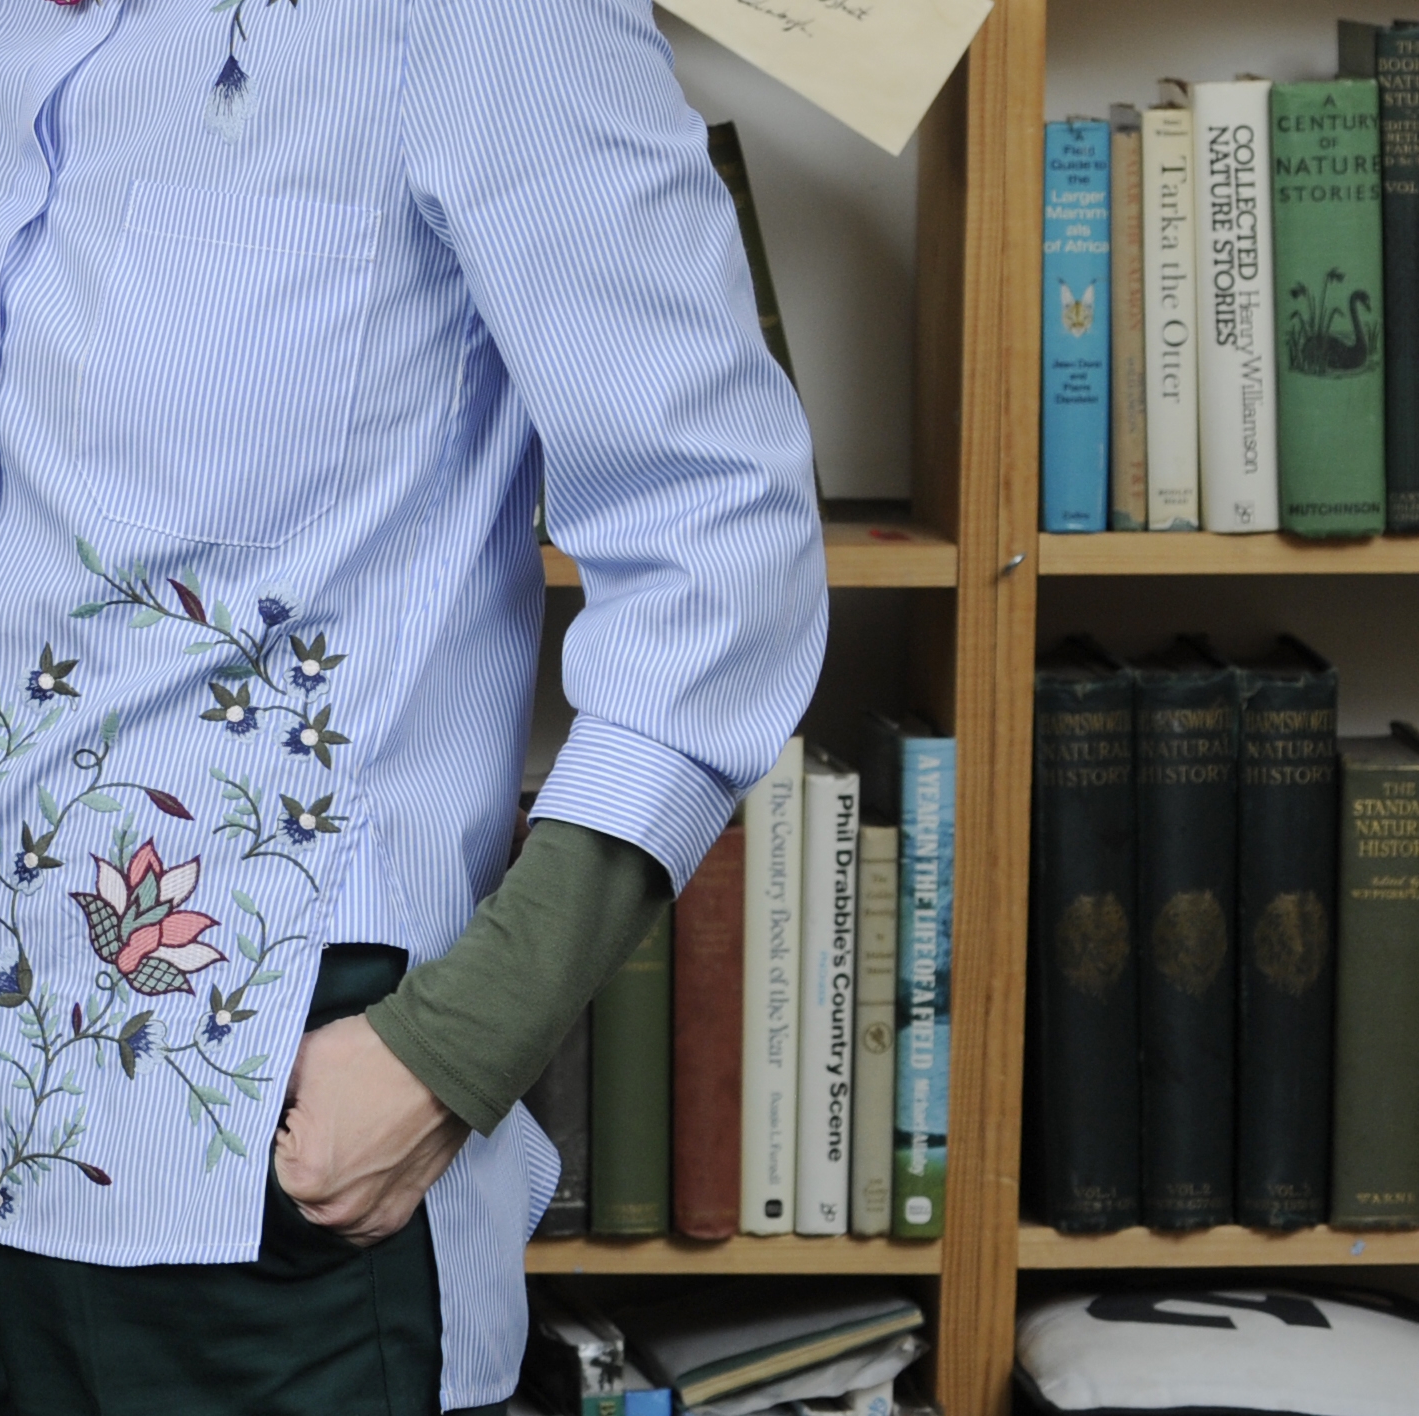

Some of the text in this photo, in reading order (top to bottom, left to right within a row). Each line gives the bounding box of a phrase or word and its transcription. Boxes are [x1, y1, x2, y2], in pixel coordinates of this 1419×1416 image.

[1323, 94, 1337, 107] A
[1277, 113, 1380, 133] CENTURY
[1063, 145, 1096, 157] Field
[1319, 136, 1339, 150] OF
[1050, 159, 1108, 171] Guide to
[1276, 154, 1382, 176] NATURE
[1067, 174, 1091, 185] the
[1051, 189, 1106, 206] Larger
[1279, 184, 1381, 203] STORIES
[1065, 223, 1092, 238] als
[1207, 124, 1238, 347] NATURE STORIES
[1043, 239, 1111, 253] of Africa
[1158, 155, 1191, 404] Tarka the Otter
[1231, 124, 1265, 475] COLLECTED Henry Williamson
[1288, 502, 1381, 517] HUTCHINSON
[1044, 742, 1132, 760] NATURAL
[1141, 738, 1234, 758] NATURAL
[1247, 739, 1336, 759] NATURAL
[917, 754, 938, 770] A
[1044, 766, 1132, 786] HISTORY
[1141, 764, 1232, 784] HISTORY
[1247, 765, 1333, 785] HISTORY
[916, 772, 938, 825] YEAR
[1383, 782, 1415, 796] THE
[915, 832, 937, 857] IN
[914, 860, 936, 904] THE
[912, 908, 935, 957] LIFE
[826, 793, 855, 1163] Phil Drabble's Country Scene
[911, 957, 934, 985] OF
[911, 988, 933, 1006] A
[909, 1005, 933, 1070] FIELD
